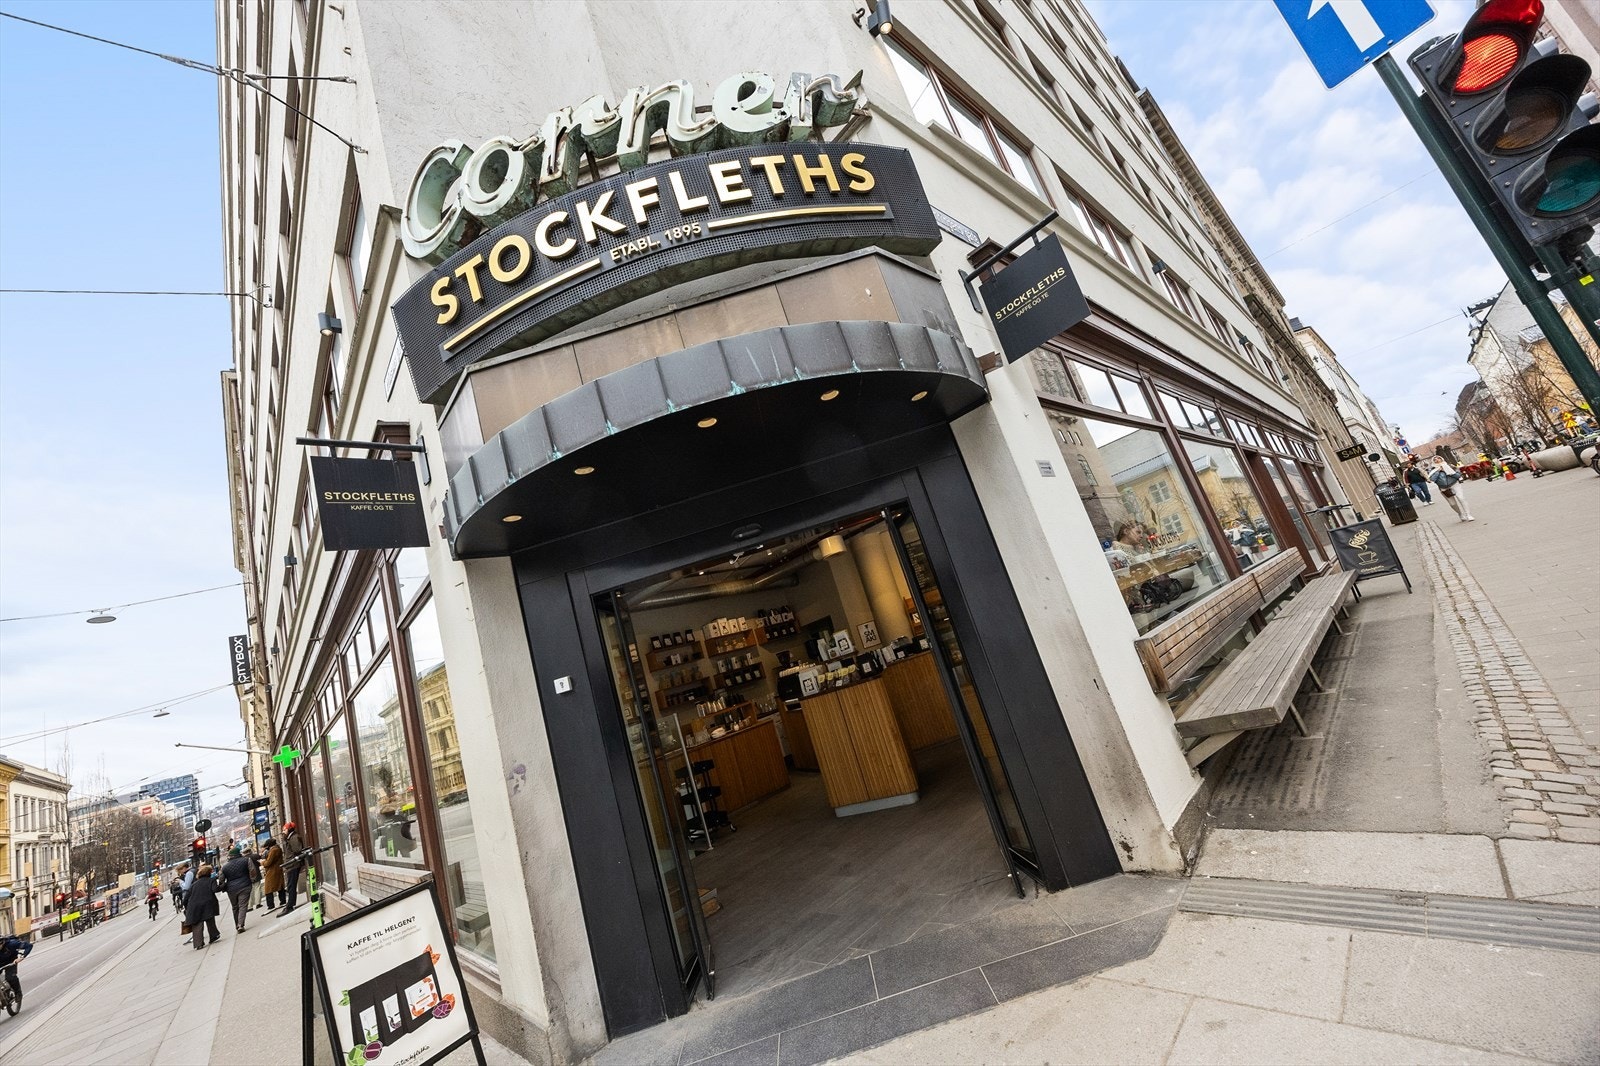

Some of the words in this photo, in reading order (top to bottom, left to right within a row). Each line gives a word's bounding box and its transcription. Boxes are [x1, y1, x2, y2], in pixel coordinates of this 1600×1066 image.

[401, 71, 862, 262] Corner
[430, 152, 878, 326] STOCKFLETHS
[609, 236, 660, 261] ETABL.
[664, 222, 702, 241] 1895
[995, 267, 1065, 319] STOCKFLETHS
[1016, 304, 1032, 317] KAFFE
[1032, 297, 1041, 306] OG
[1041, 292, 1049, 300] TE
[324, 491, 416, 501] STOCKFLETHS
[234, 637, 247, 683] CITYBOX
[346, 934, 372, 950] KAFFE
[373, 930, 384, 939] TIL
[384, 916, 416, 934] HELGEN?
